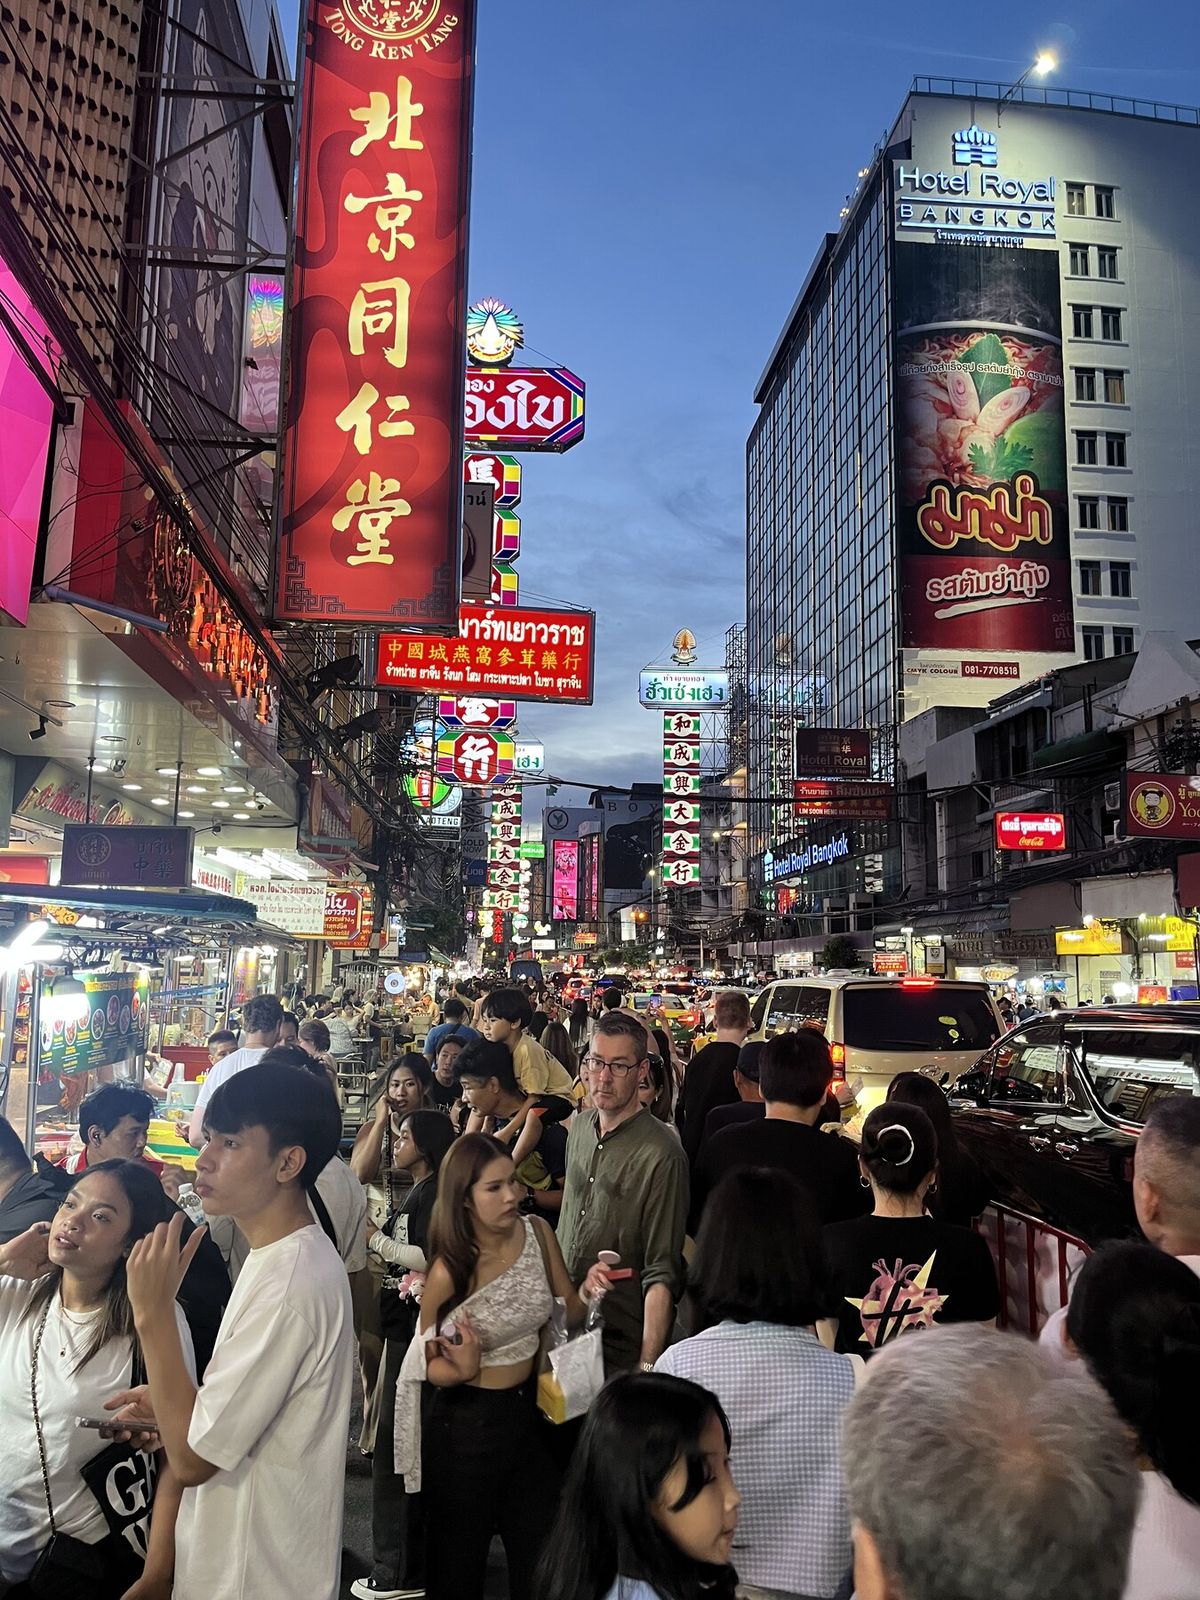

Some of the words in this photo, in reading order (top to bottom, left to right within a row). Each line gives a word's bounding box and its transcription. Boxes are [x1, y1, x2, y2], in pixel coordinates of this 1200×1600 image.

[324, 8, 365, 51] TONG
[369, 40, 414, 60] REN
[415, 14, 459, 52] TANG
[900, 166, 970, 194] Hotel
[981, 174, 1056, 204] Royal
[900, 204, 1056, 229] BANGKOK
[332, 75, 424, 566] 北京同仁堂
[918, 474, 1053, 551] มาม่า
[926, 560, 1050, 601] รสต้มยำกุ้ง
[386, 640, 582, 671] 中國城燕窩參茸藥行
[965, 665, 1018, 676] 081-7708518
[386, 661, 417, 679] จำหน่าย
[420, 665, 440, 680] ยาจีน
[443, 666, 463, 681] รังนก
[465, 666, 481, 682] โสม
[484, 673, 532, 687] กระเพาะปลา
[534, 671, 554, 688] ใบชา
[557, 674, 582, 693] สุราจีน
[646, 678, 723, 700] ฮั่วเซ่งเฮง
[800, 754, 830, 765] Hotel
[834, 755, 867, 767] Royal
[671, 715, 691, 881] 和成興大金行
[774, 853, 791, 877] Hotel
[792, 846, 811, 874] Royal
[813, 833, 848, 865] Bangkok
[1019, 836, 1044, 846] Coca-Cola
